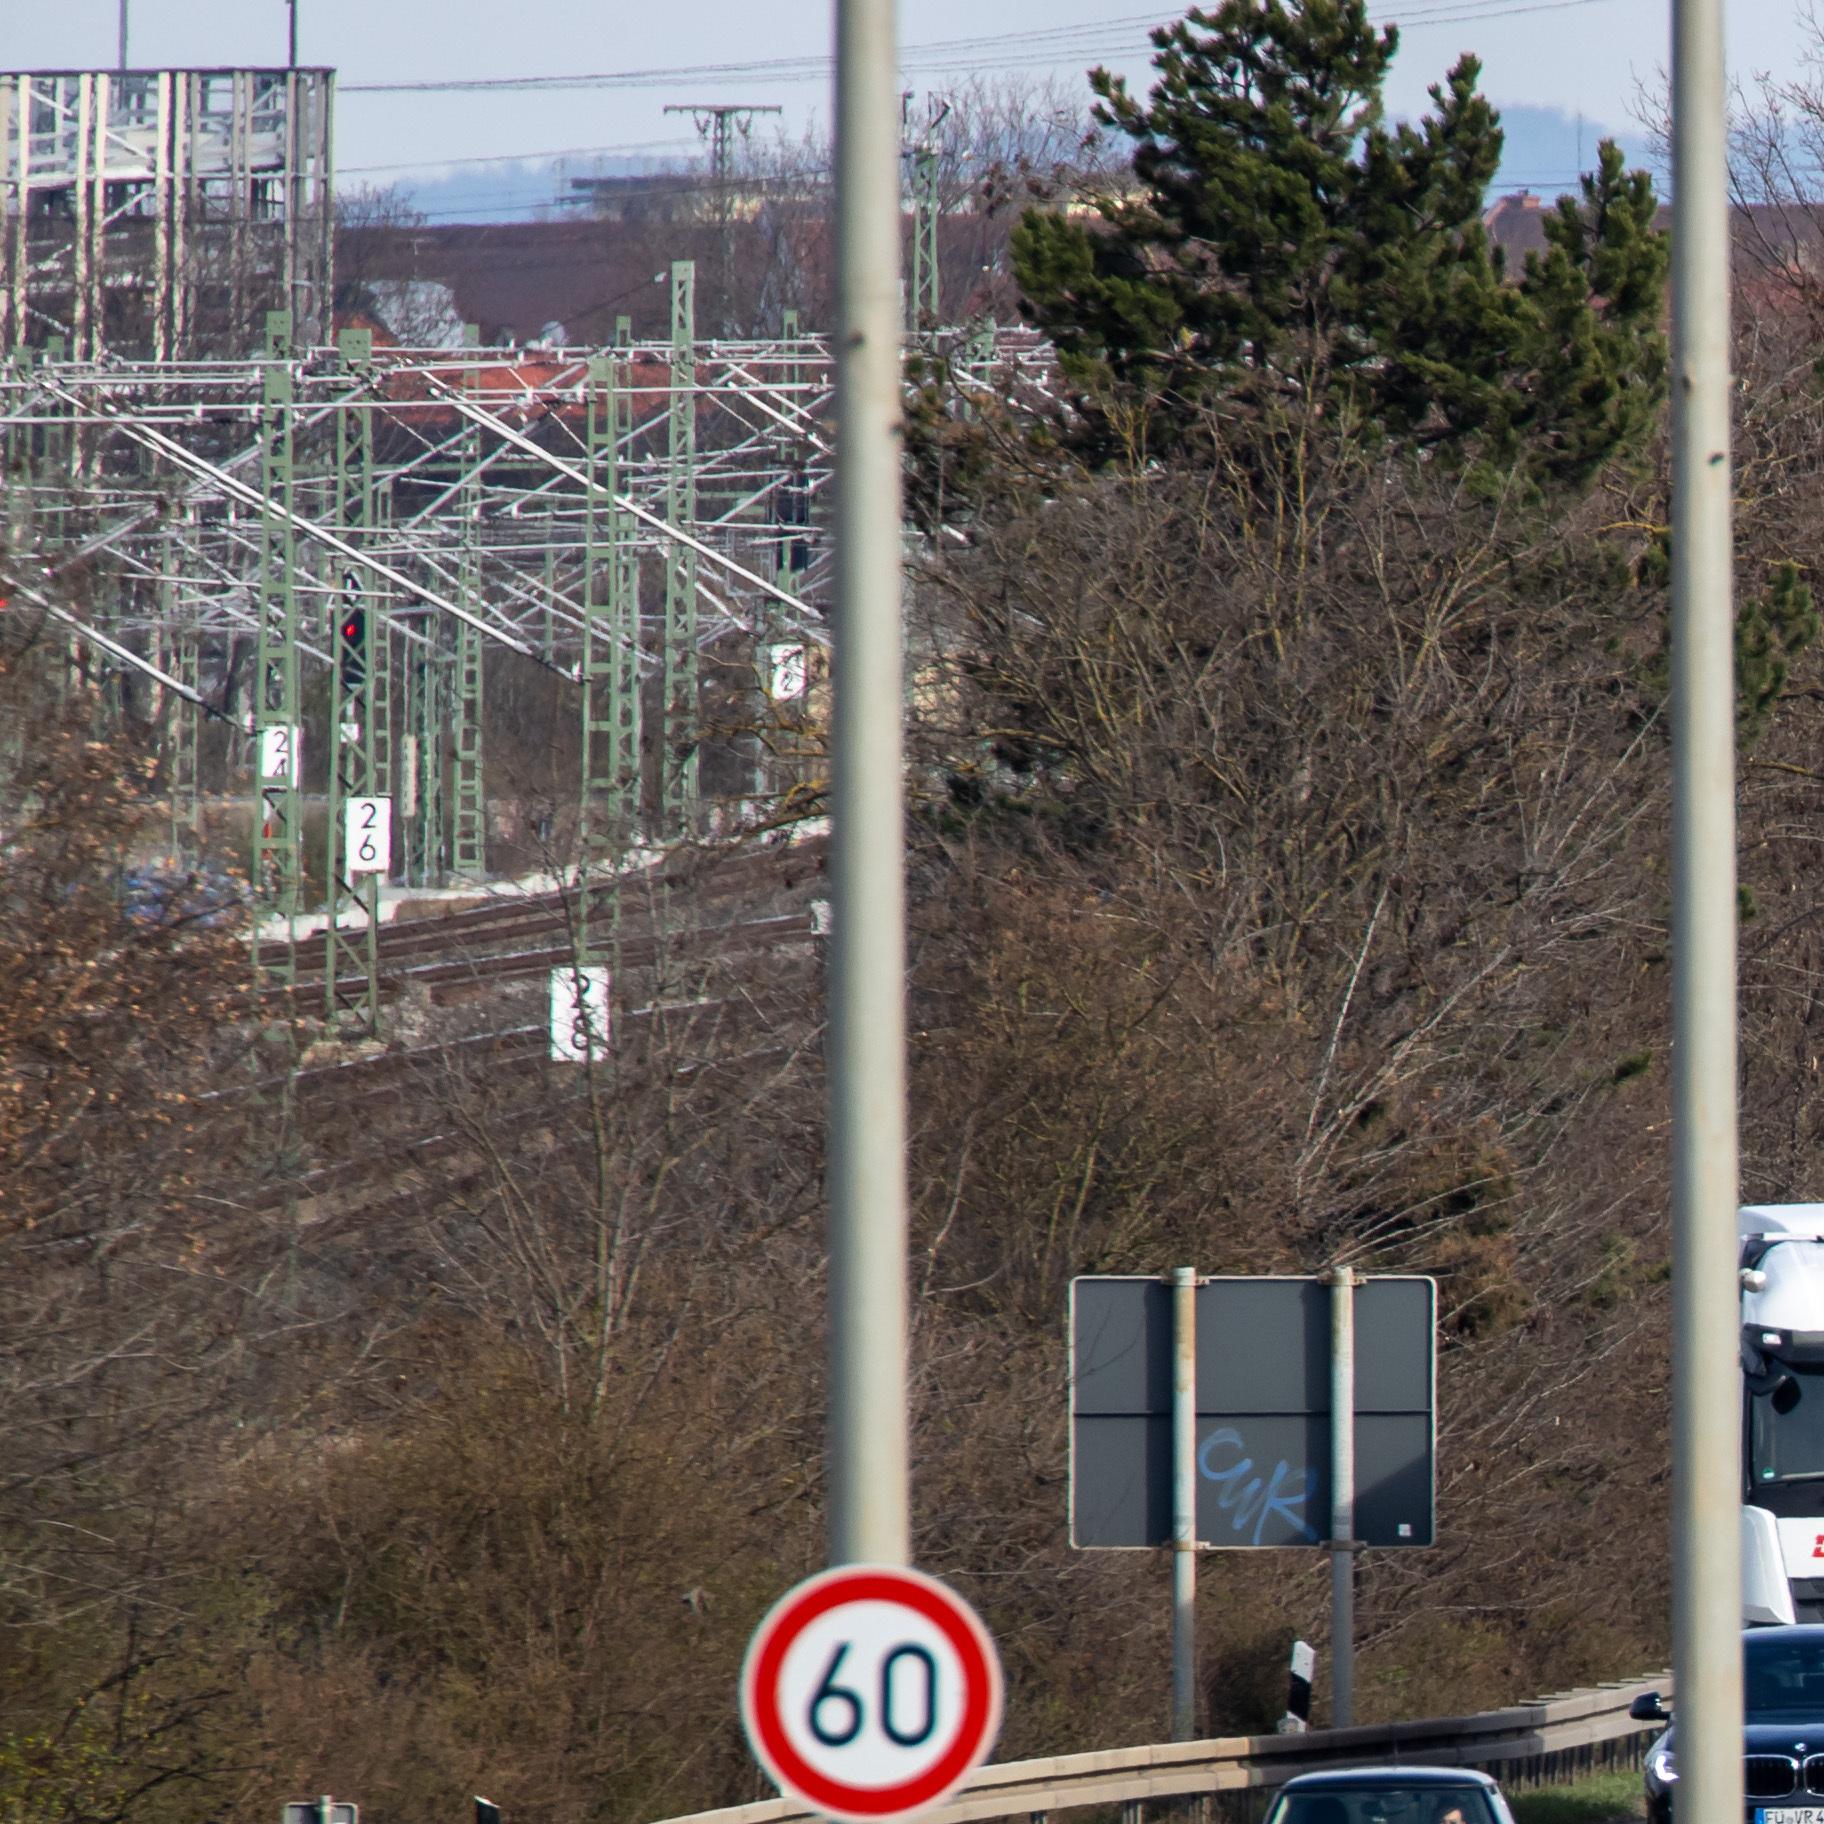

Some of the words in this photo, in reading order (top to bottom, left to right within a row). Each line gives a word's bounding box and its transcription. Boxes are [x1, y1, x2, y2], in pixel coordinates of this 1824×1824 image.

[361, 803, 376, 828] 2
[360, 835, 376, 861] 6
[808, 1640, 937, 1748] 60
[1795, 1810, 1813, 1824] VR
